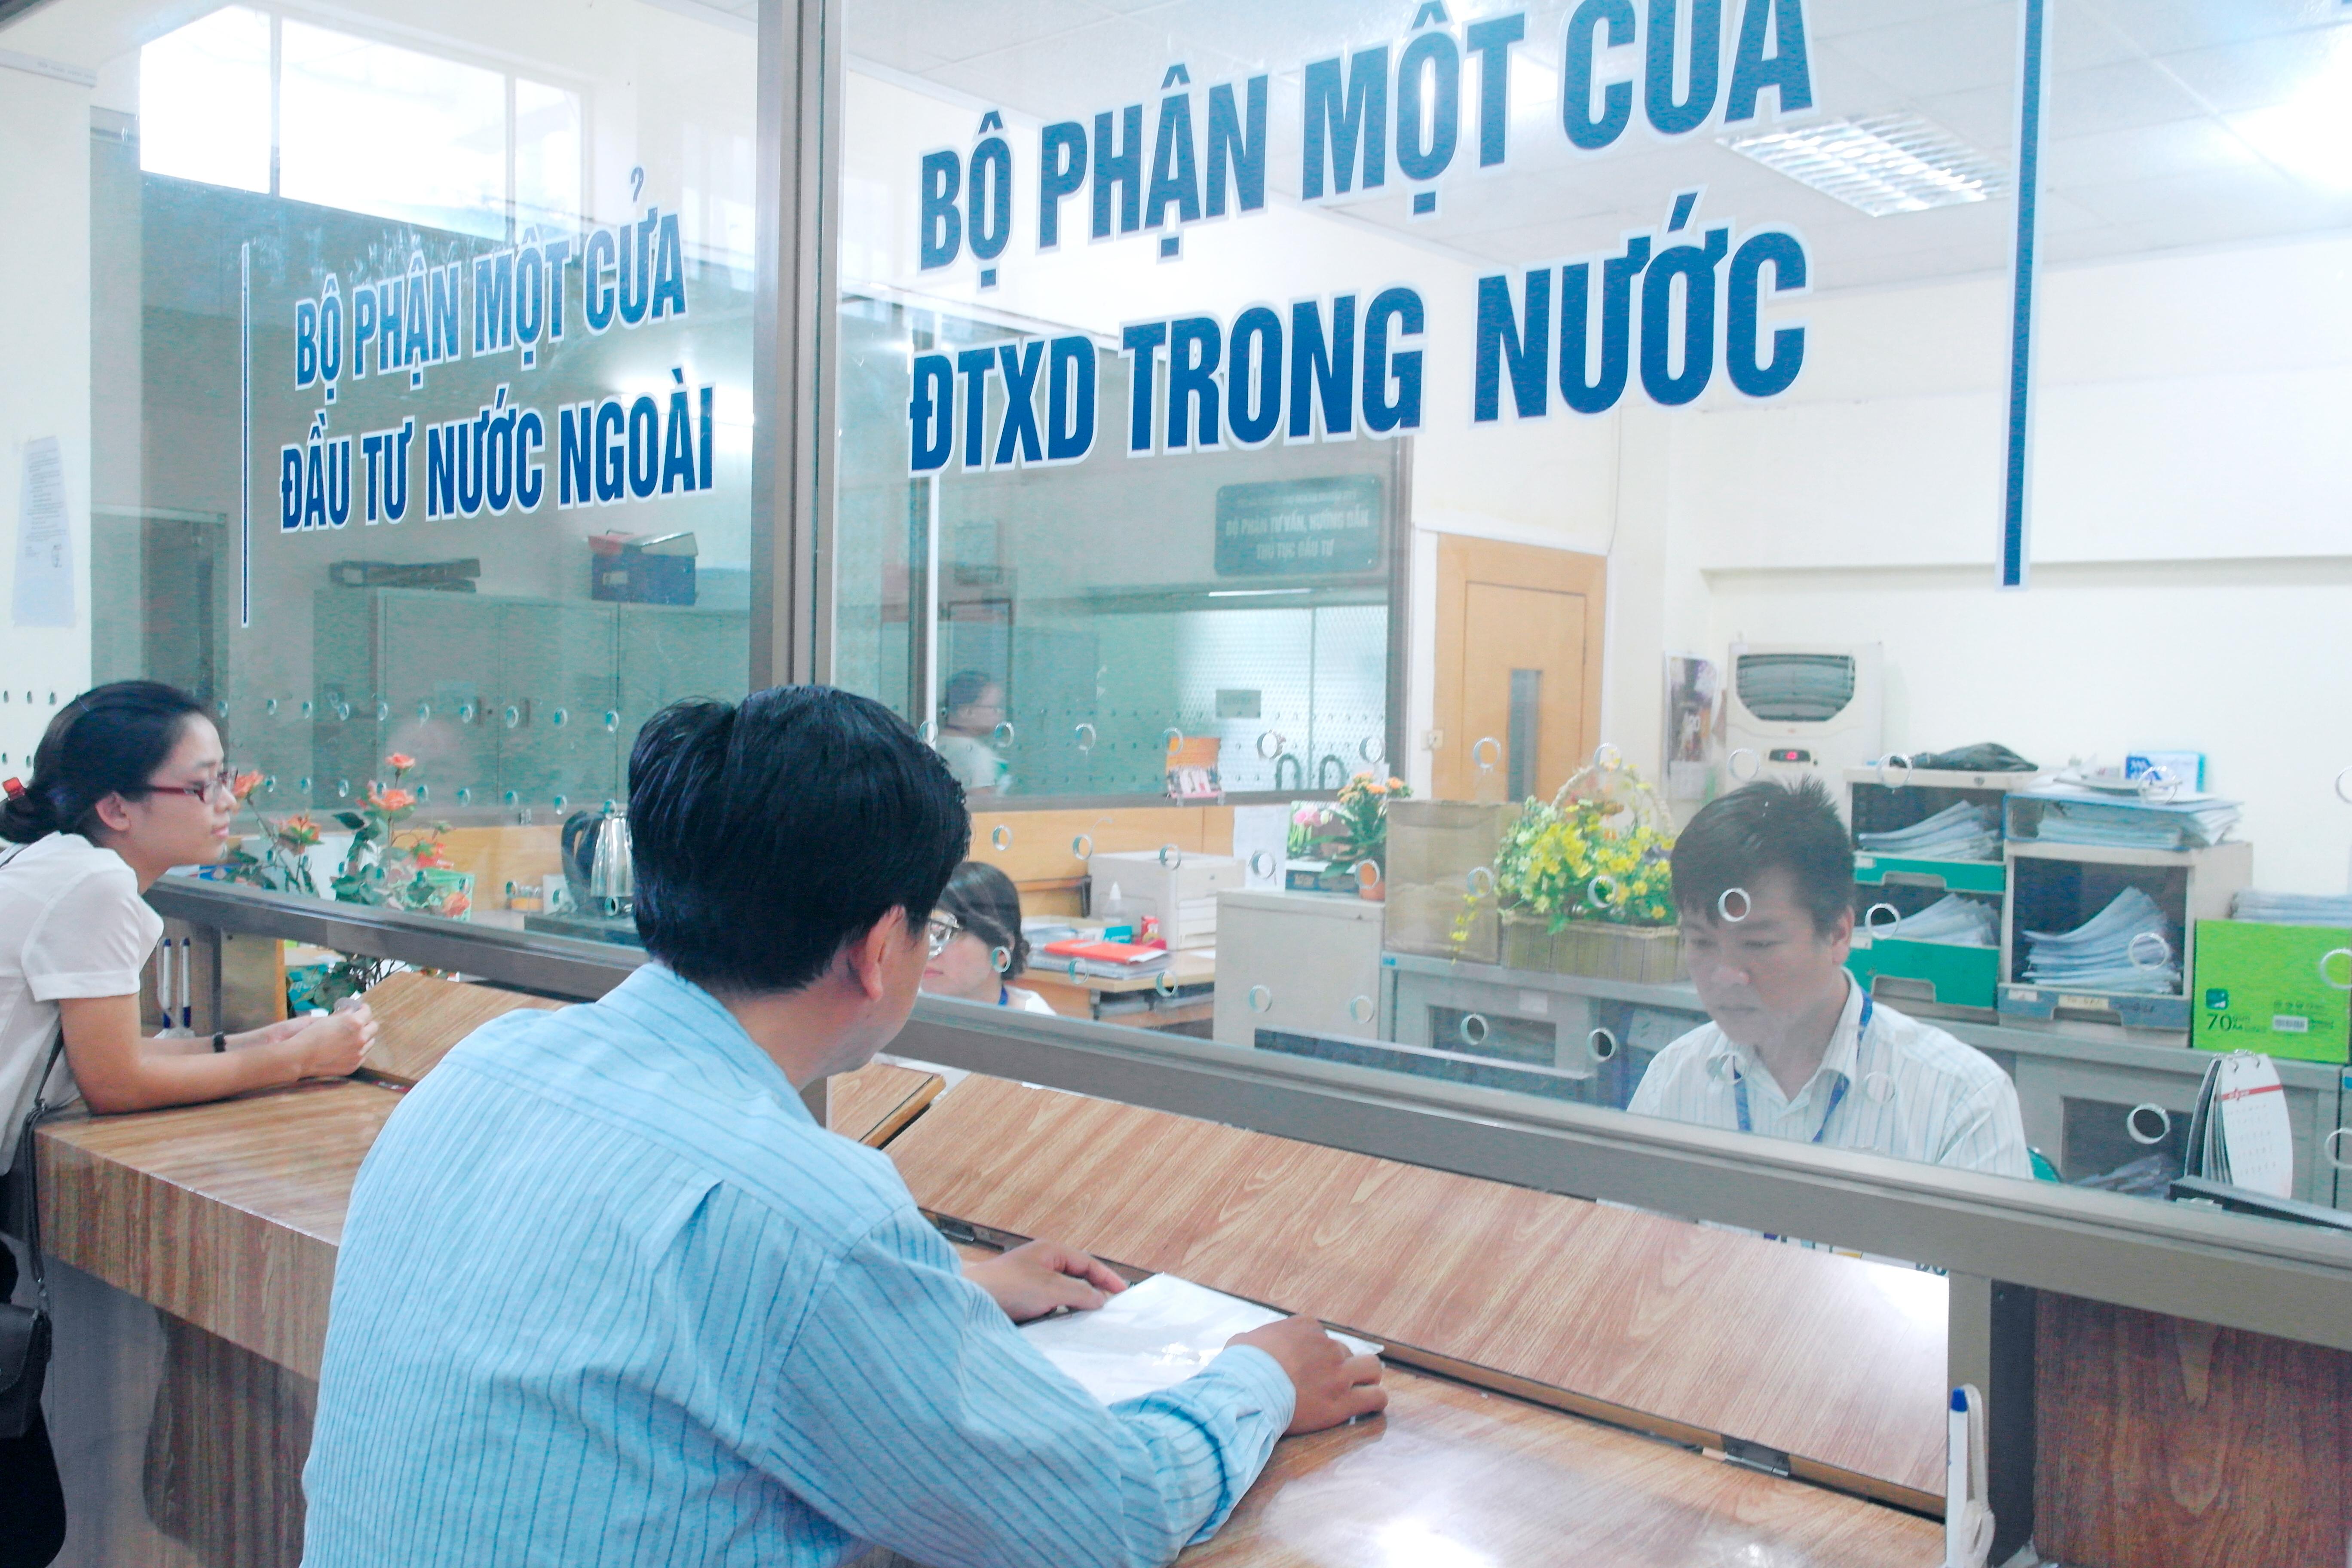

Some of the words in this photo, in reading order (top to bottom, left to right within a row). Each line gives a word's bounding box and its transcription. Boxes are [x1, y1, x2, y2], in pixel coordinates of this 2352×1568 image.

[920, 112, 1011, 287] BỘ
[1040, 65, 1267, 257] PHẬN
[1303, 2, 1525, 214] MỘT
[297, 275, 342, 400] BỘ
[355, 252, 459, 385] PHẬN
[475, 228, 572, 365] MỘT
[585, 166, 687, 334] CỬA
[910, 337, 1096, 471] ĐTXD
[1123, 287, 1424, 452] TRONG
[1474, 193, 1806, 423] NƯỚC
[282, 411, 349, 530] ĐẦU
[363, 422, 413, 524] TƯ
[429, 385, 543, 519] NƯỚC
[560, 368, 713, 507] NGOÀI
[2207, 1014, 2232, 1031] 70
